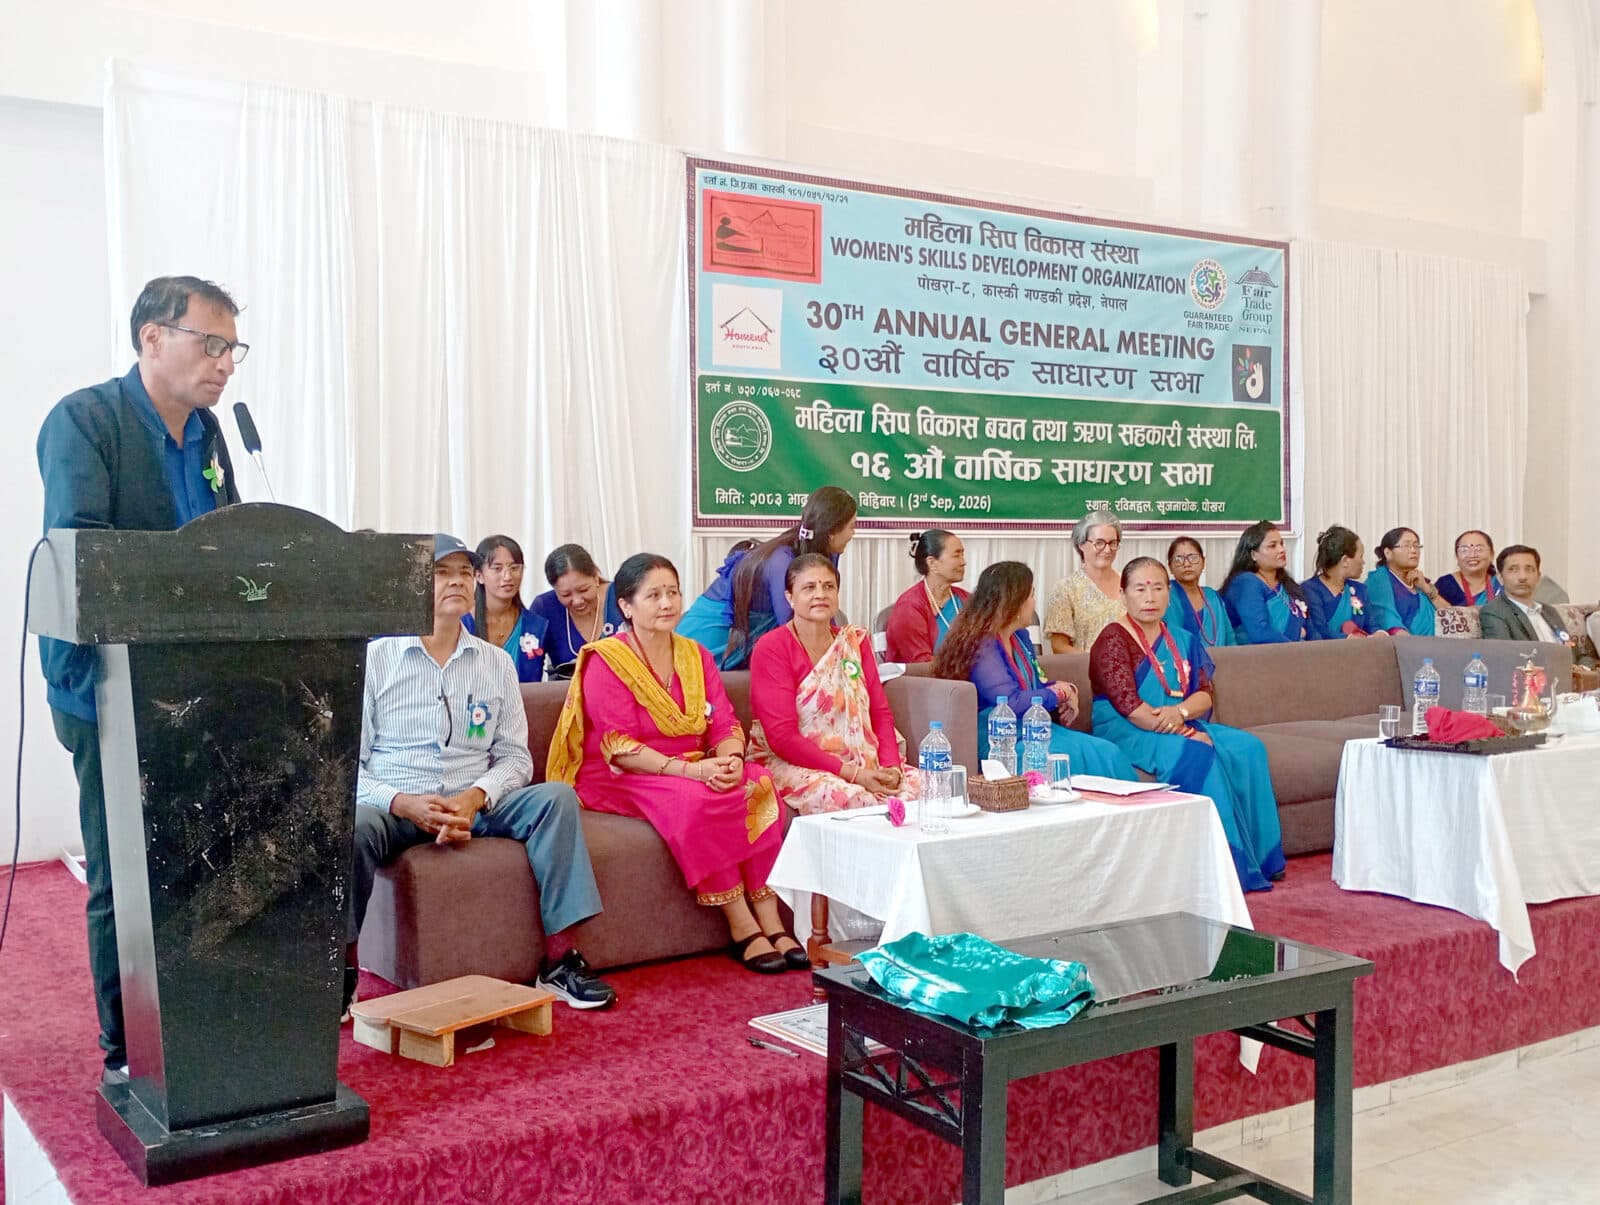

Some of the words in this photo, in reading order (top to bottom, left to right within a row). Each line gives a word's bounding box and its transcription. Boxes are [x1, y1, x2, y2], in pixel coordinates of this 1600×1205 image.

[761, 184, 785, 195] कास्की
[905, 213, 973, 245] महिला
[979, 220, 1018, 250] सिप
[1024, 226, 1086, 260] विकास
[1091, 239, 1140, 265] संस्था
[831, 236, 913, 265] WOMEN'S
[918, 247, 967, 271] SKILLS
[972, 254, 1078, 283] DEVELOPMENT
[1082, 266, 1186, 296] ORGANIZATION
[982, 283, 1019, 300] कास्की
[1024, 287, 1064, 305] गण्डकी
[1068, 290, 1095, 310] प्रदेश,
[1100, 293, 1128, 311] नेपाल
[1242, 285, 1272, 298] Fair
[1241, 296, 1272, 311] Trade
[1183, 310, 1233, 323] GUARANTEED
[1187, 320, 1203, 329] FAIR
[1204, 321, 1230, 332] TRADE
[1242, 308, 1273, 325] Group
[806, 300, 864, 331] 30TH
[873, 307, 992, 343] ANNUAL
[1000, 319, 1110, 353] GENERAL
[1116, 330, 1215, 361] MEETING
[818, 340, 905, 375] ३०औं
[922, 348, 1015, 381] वार्षिक
[1031, 361, 1138, 390] साधारण
[1149, 370, 1205, 395] सभा
[704, 380, 721, 394] दर्ता
[794, 399, 865, 434] महिला
[871, 402, 911, 436] सिप
[916, 405, 980, 440] विकास
[985, 417, 1027, 441] बचत
[1032, 419, 1068, 443] तथा
[1072, 421, 1114, 444] ऋण
[1118, 420, 1183, 448] सहकारी
[1187, 423, 1232, 449] संस्था
[1235, 422, 1258, 450] लि.
[851, 451, 891, 481] १६
[954, 447, 1043, 482] वार्षिक
[1051, 458, 1154, 486] साधारण
[1160, 462, 1214, 487] सभा
[715, 487, 745, 505] मिति:
[749, 492, 783, 508] २०८३
[930, 494, 956, 513] Sep,
[959, 494, 991, 513] 2026)
[1085, 499, 1111, 511] स्थान:
[1201, 498, 1225, 512] पोखरा
